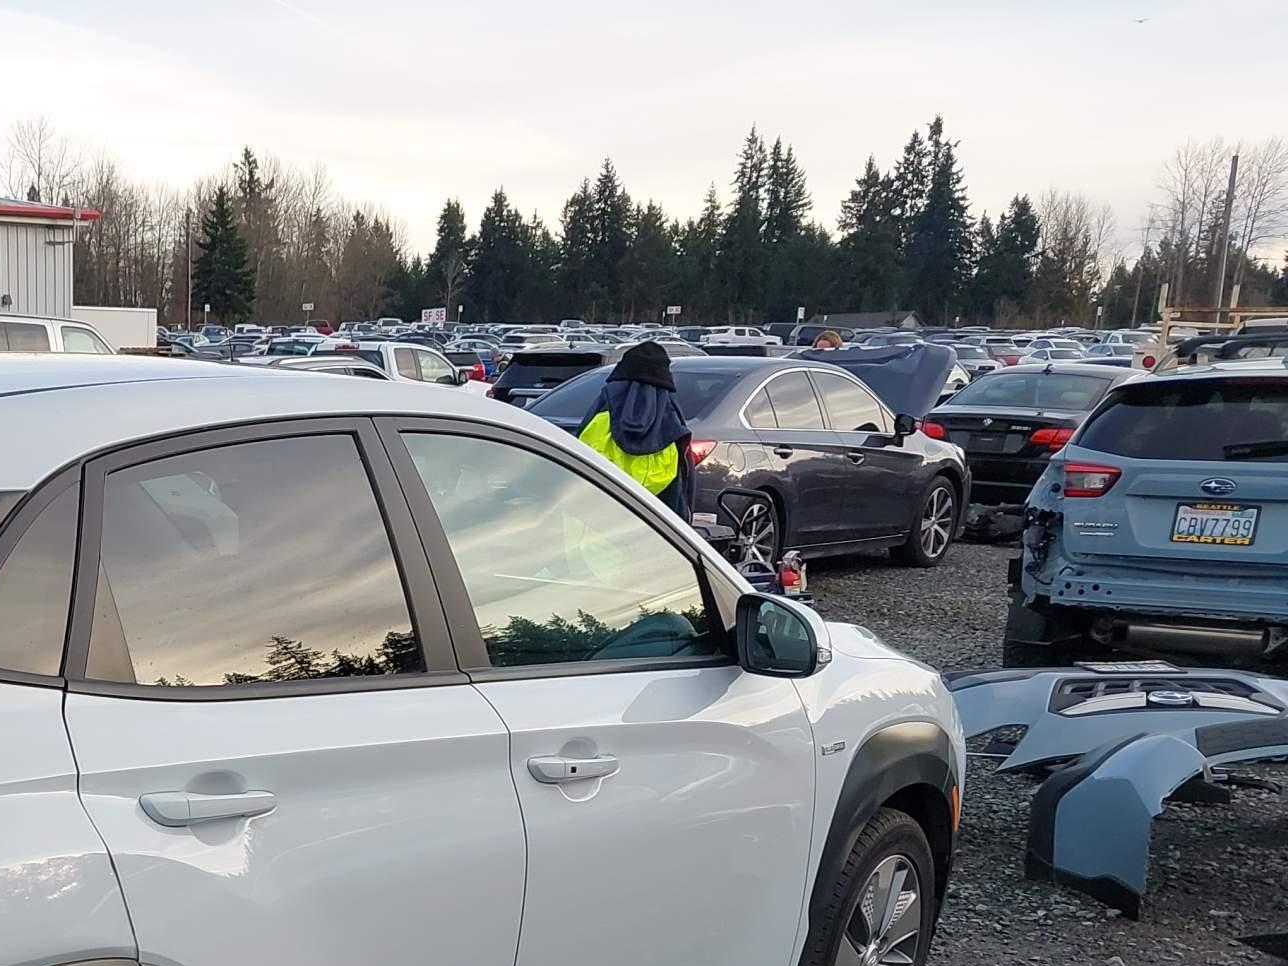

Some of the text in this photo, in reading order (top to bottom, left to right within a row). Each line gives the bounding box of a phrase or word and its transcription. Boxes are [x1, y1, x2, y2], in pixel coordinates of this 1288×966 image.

[1195, 503, 1241, 511] SEATTLE
[1176, 517, 1253, 537] CBV7799
[1173, 534, 1250, 545] CARTER
